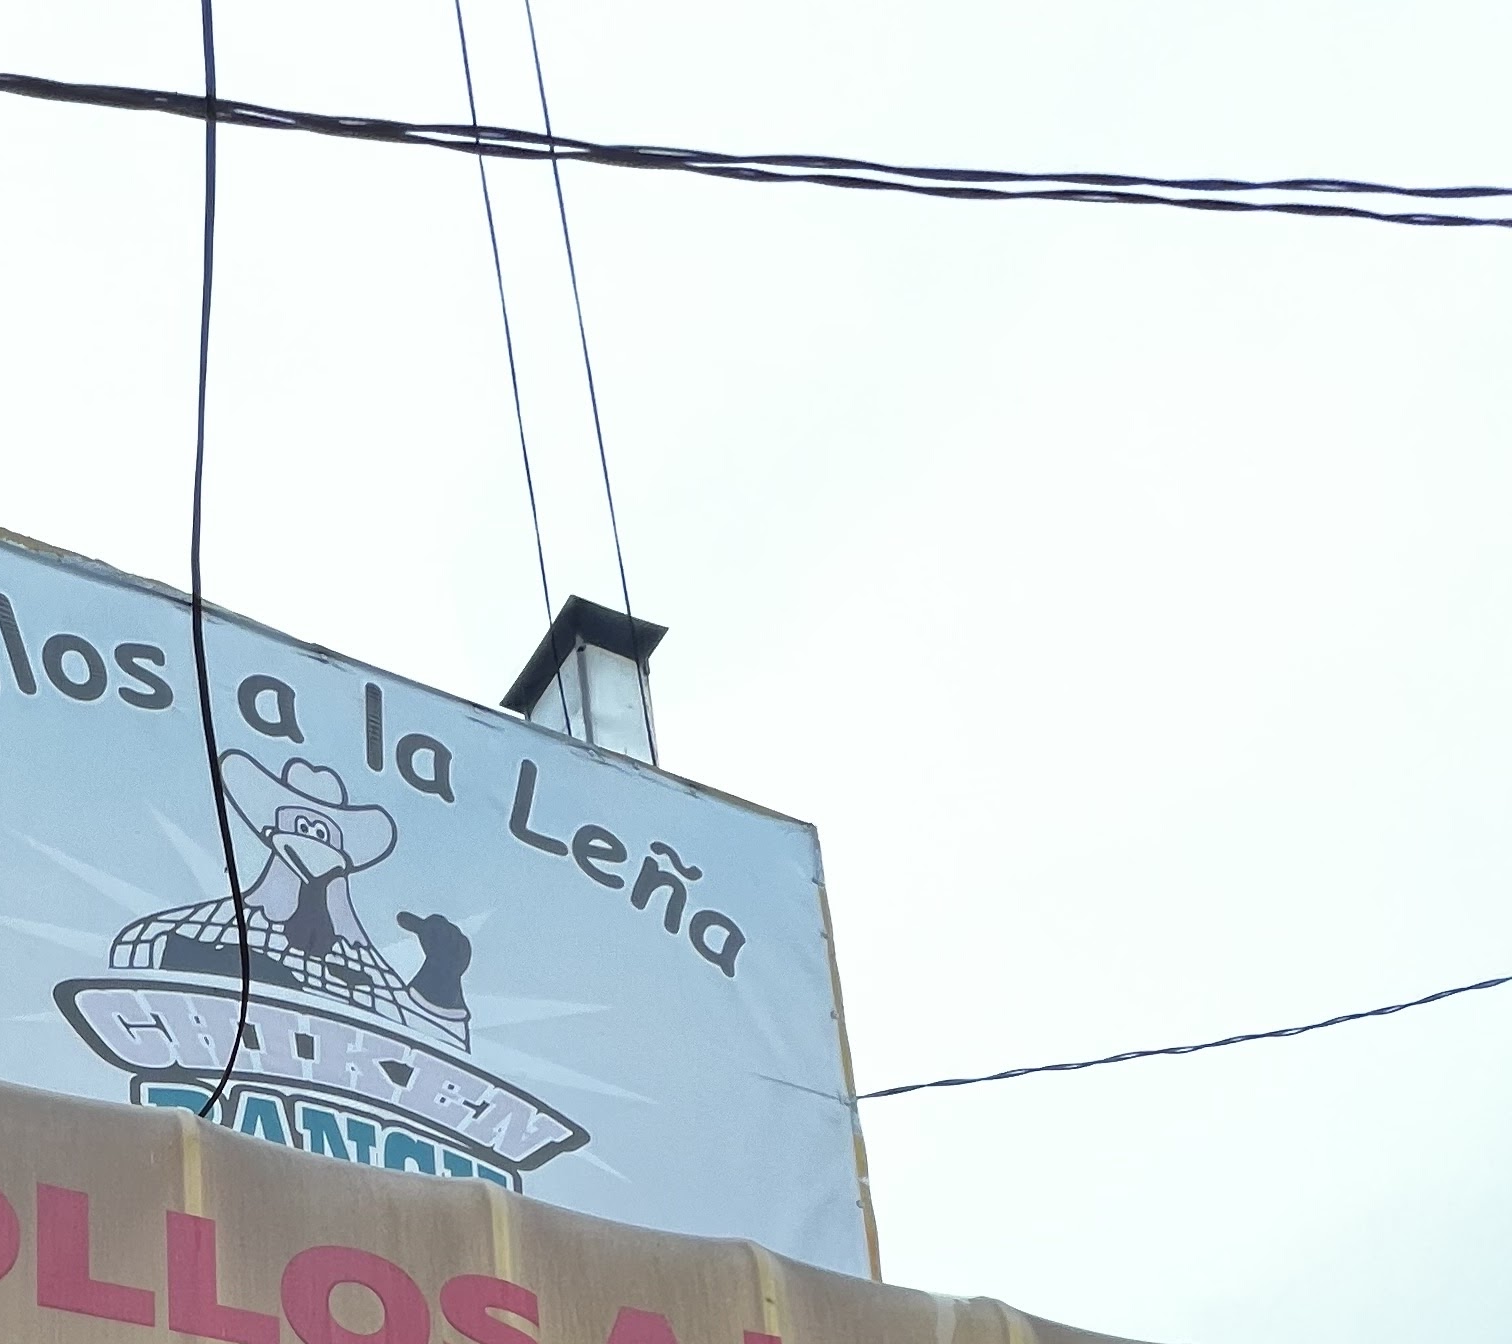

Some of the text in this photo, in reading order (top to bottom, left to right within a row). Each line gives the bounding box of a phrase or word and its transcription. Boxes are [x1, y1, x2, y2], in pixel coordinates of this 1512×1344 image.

[236, 674, 304, 744] a
[363, 681, 455, 803] la
[510, 758, 746, 979] Leña
[75, 989, 573, 1163] CHIKEN
